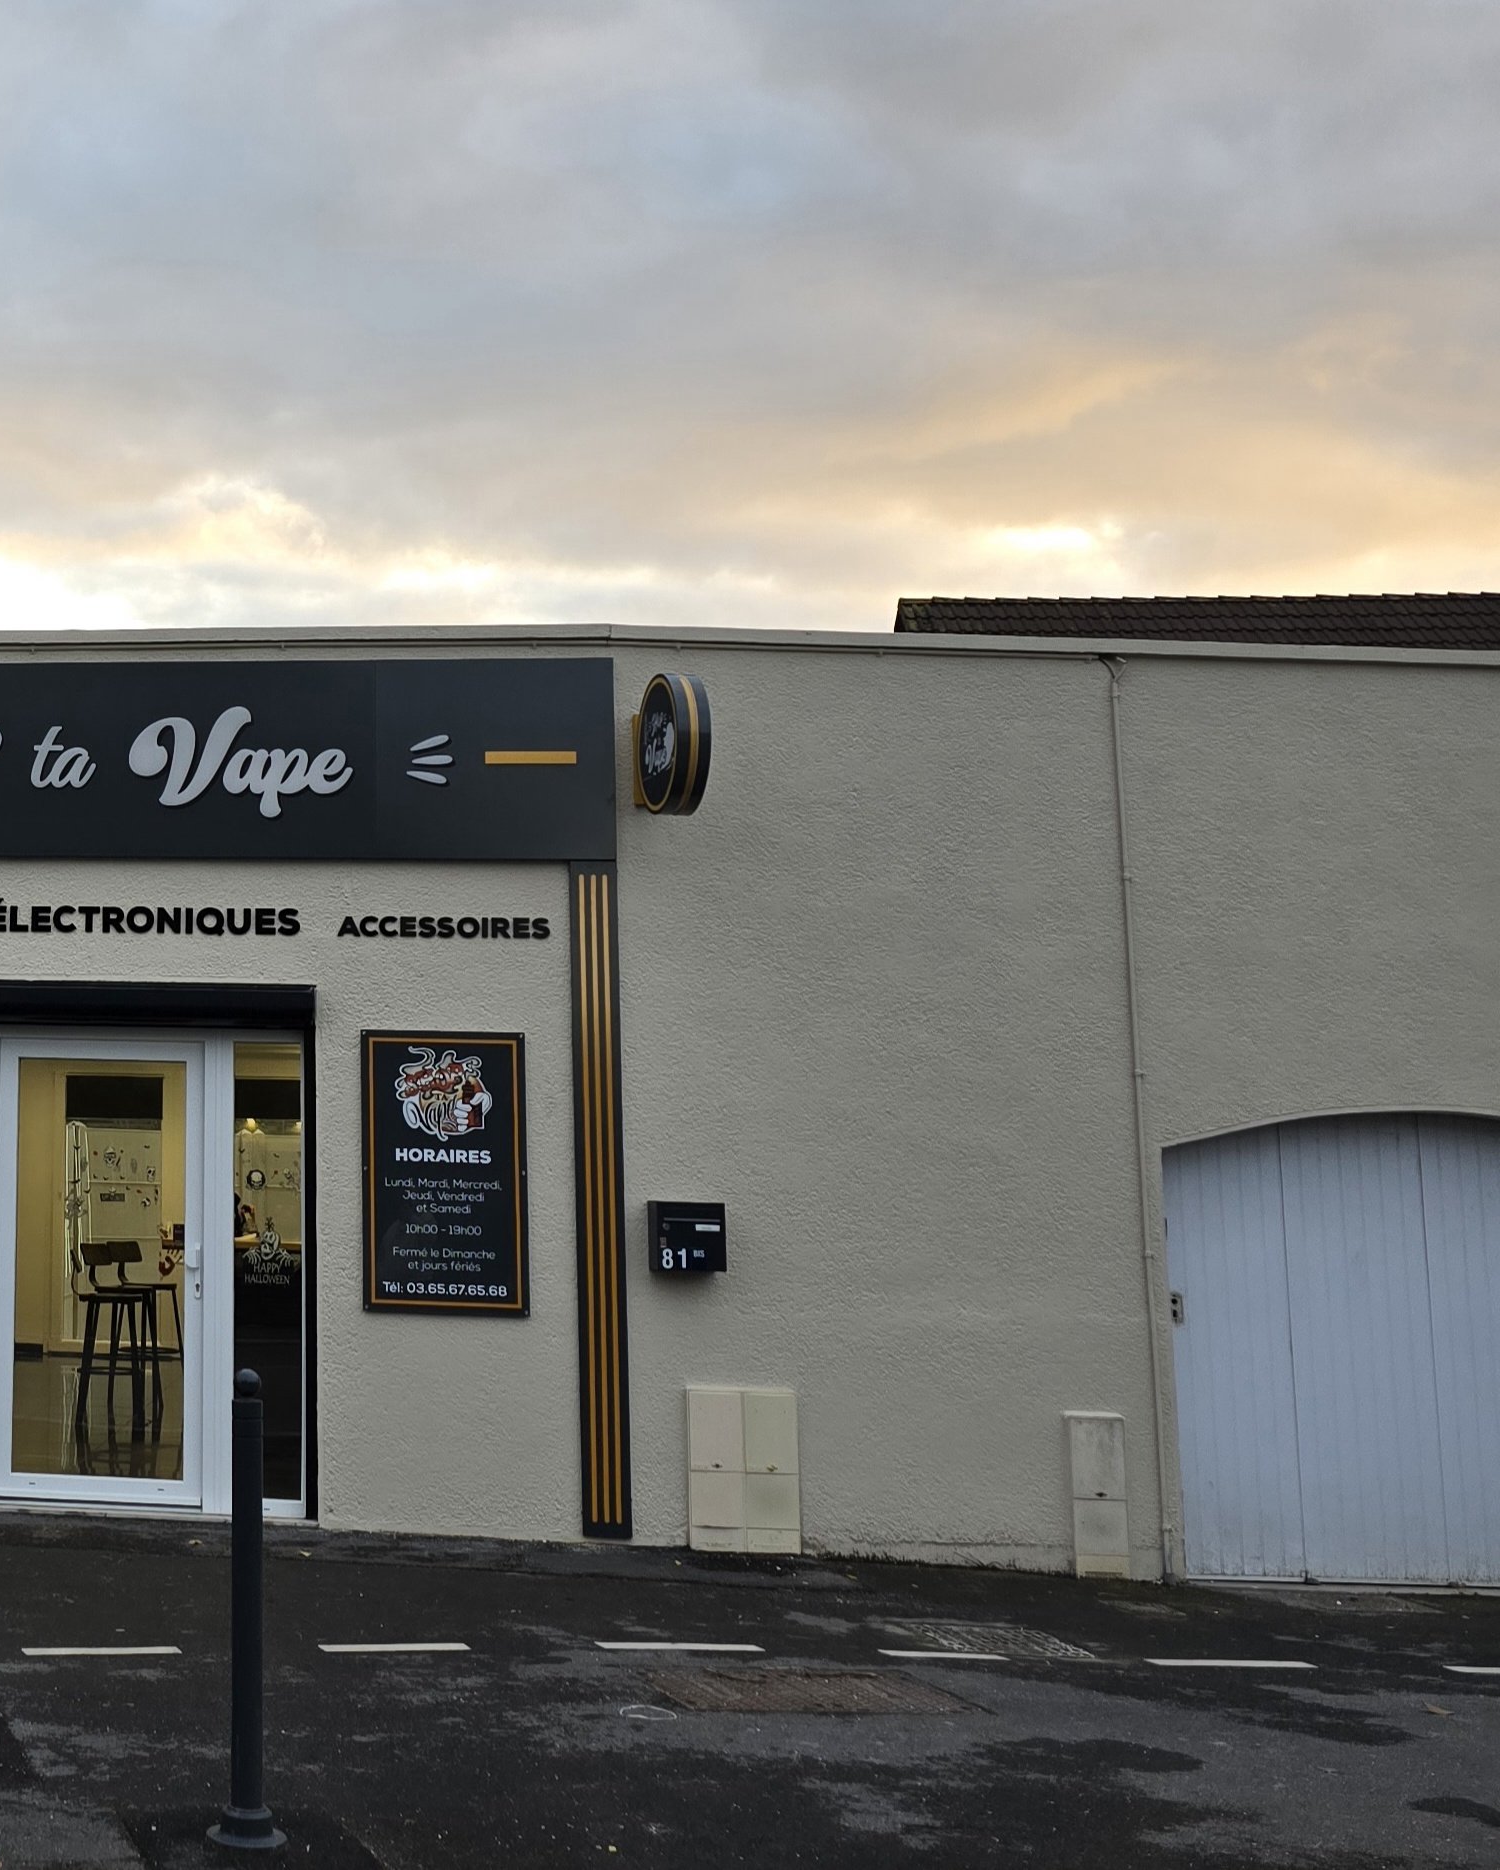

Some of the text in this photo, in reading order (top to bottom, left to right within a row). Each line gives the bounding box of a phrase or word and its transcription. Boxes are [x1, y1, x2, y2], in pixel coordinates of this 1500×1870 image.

[30, 726, 97, 789] ta
[128, 706, 354, 818] Vape
[337, 915, 551, 940] ACCESSOIRES
[395, 1147, 492, 1164] HORAIRES
[384, 1177, 502, 1191] Lundi, Mardi, Mercredi,
[402, 1190, 485, 1202] Jeudi, Vendredi
[416, 1203, 471, 1214] et Samedi
[406, 1223, 438, 1234] 10h00
[449, 1225, 482, 1236] 19h00
[392, 1246, 496, 1260] Fermé le Dimanche
[662, 1248, 687, 1269] 81
[253, 1262, 281, 1273] HAPPY
[408, 1260, 482, 1272] et jours fériés
[244, 1273, 290, 1285] HALLOWEEN
[382, 1281, 508, 1297] Tél: 03.65.67.65.68
